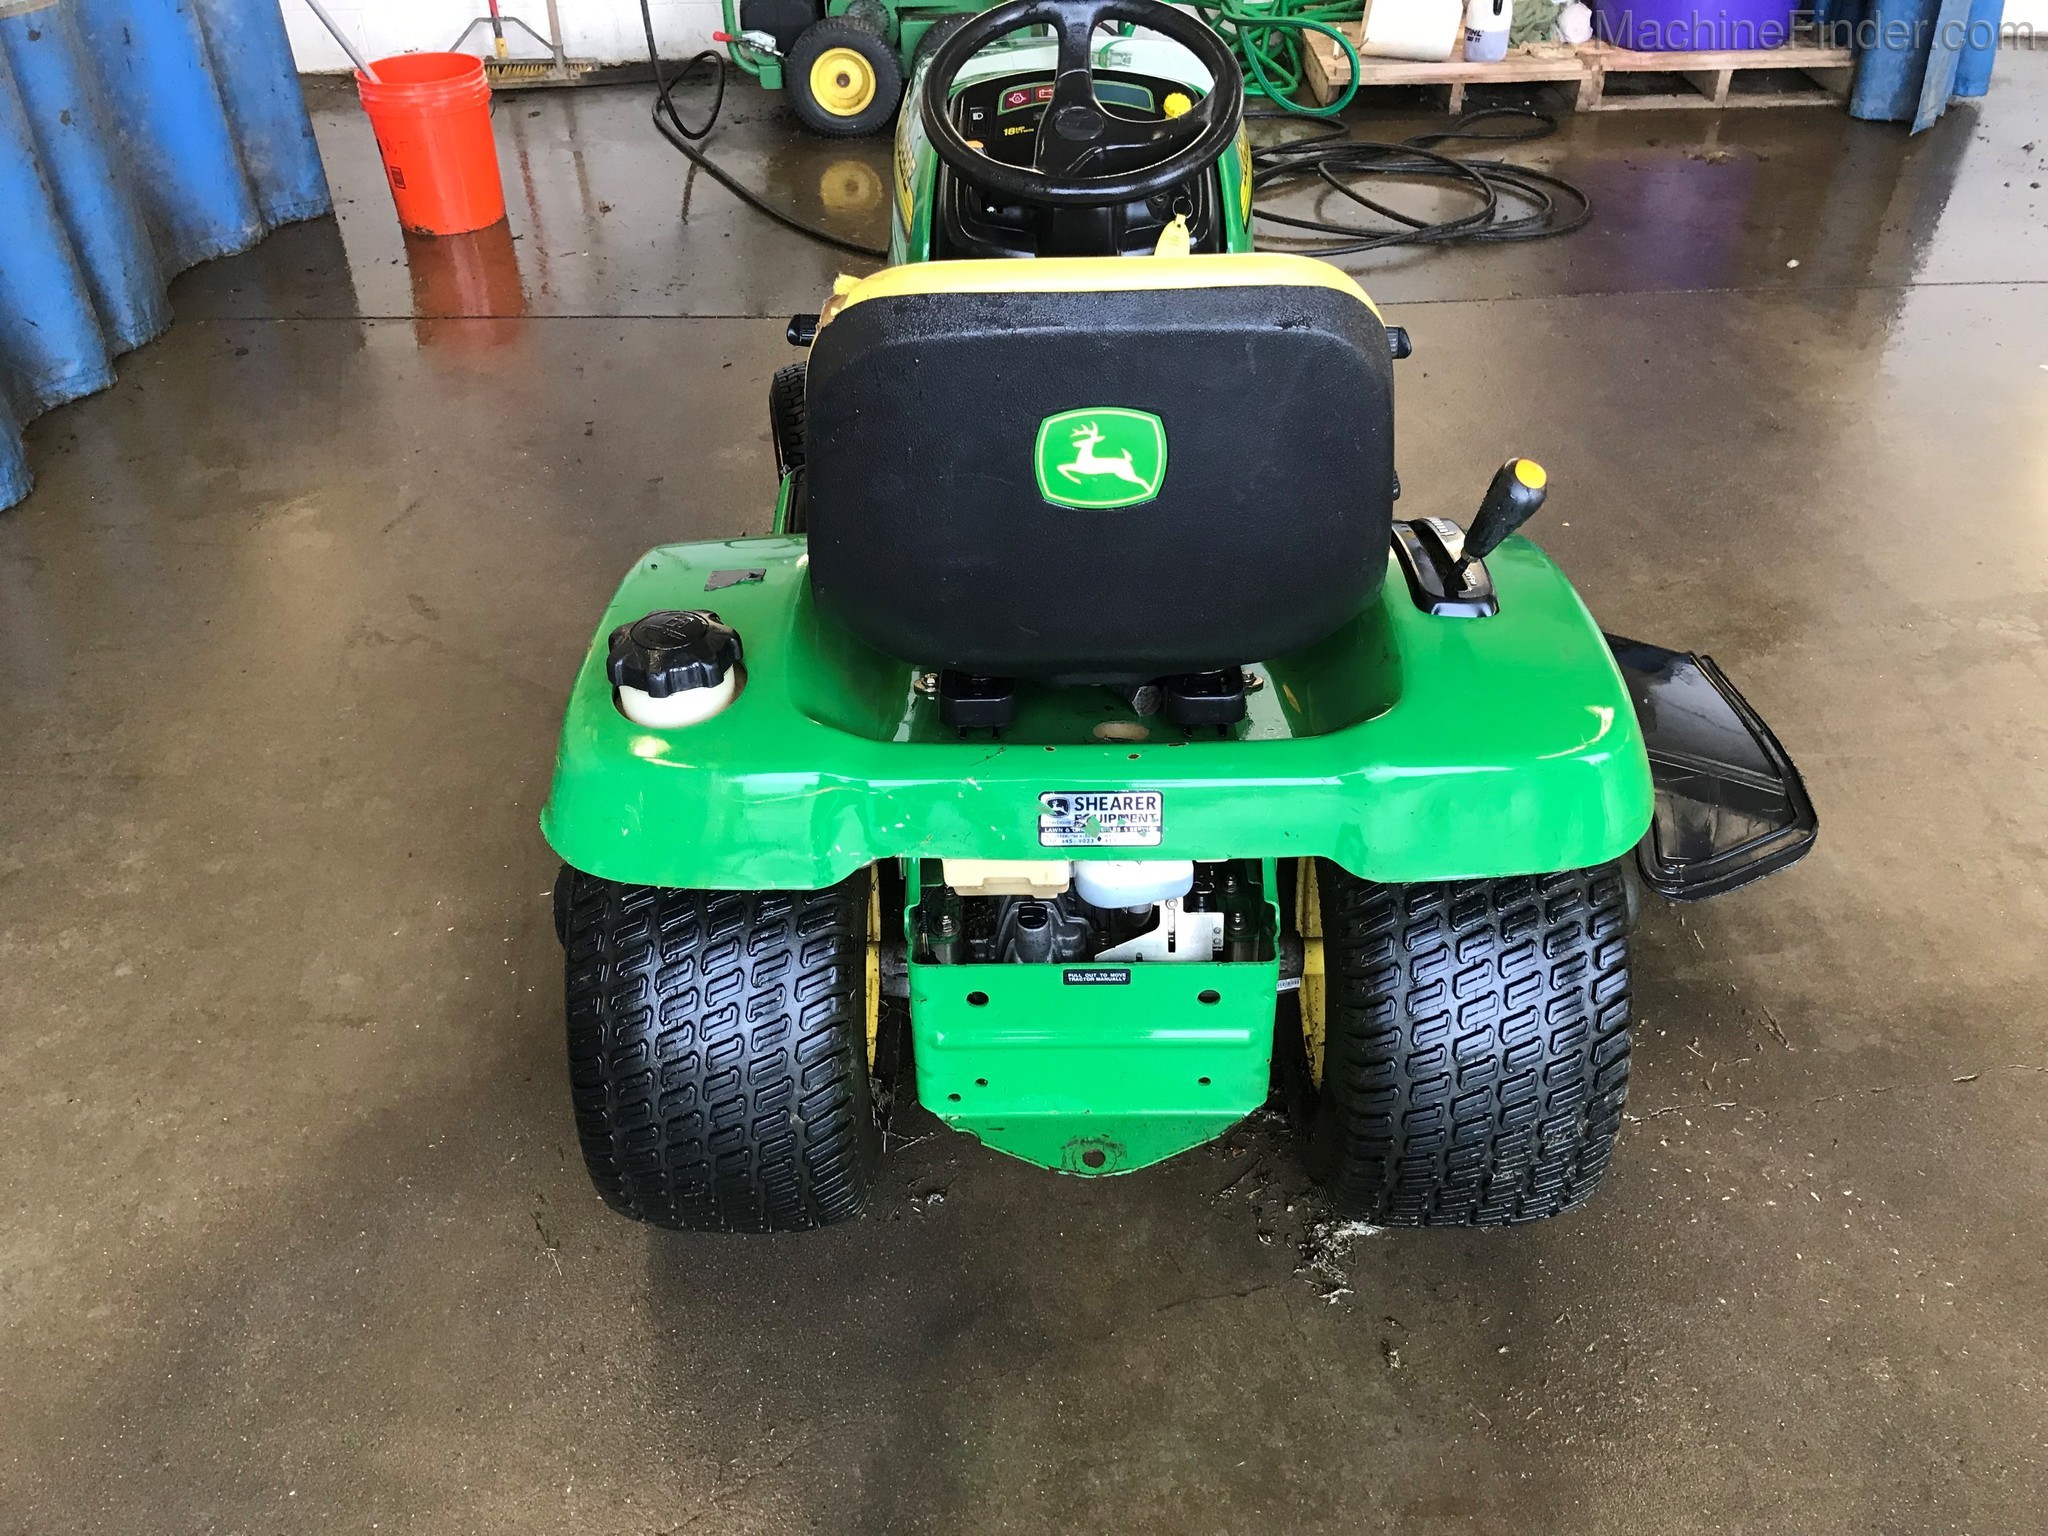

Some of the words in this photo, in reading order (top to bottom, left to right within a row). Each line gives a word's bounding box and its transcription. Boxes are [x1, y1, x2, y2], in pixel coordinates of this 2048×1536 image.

[1003, 127, 1016, 136] 18
[1074, 796, 1157, 811] SHEARER
[1074, 813, 1158, 824] EUIPMENT
